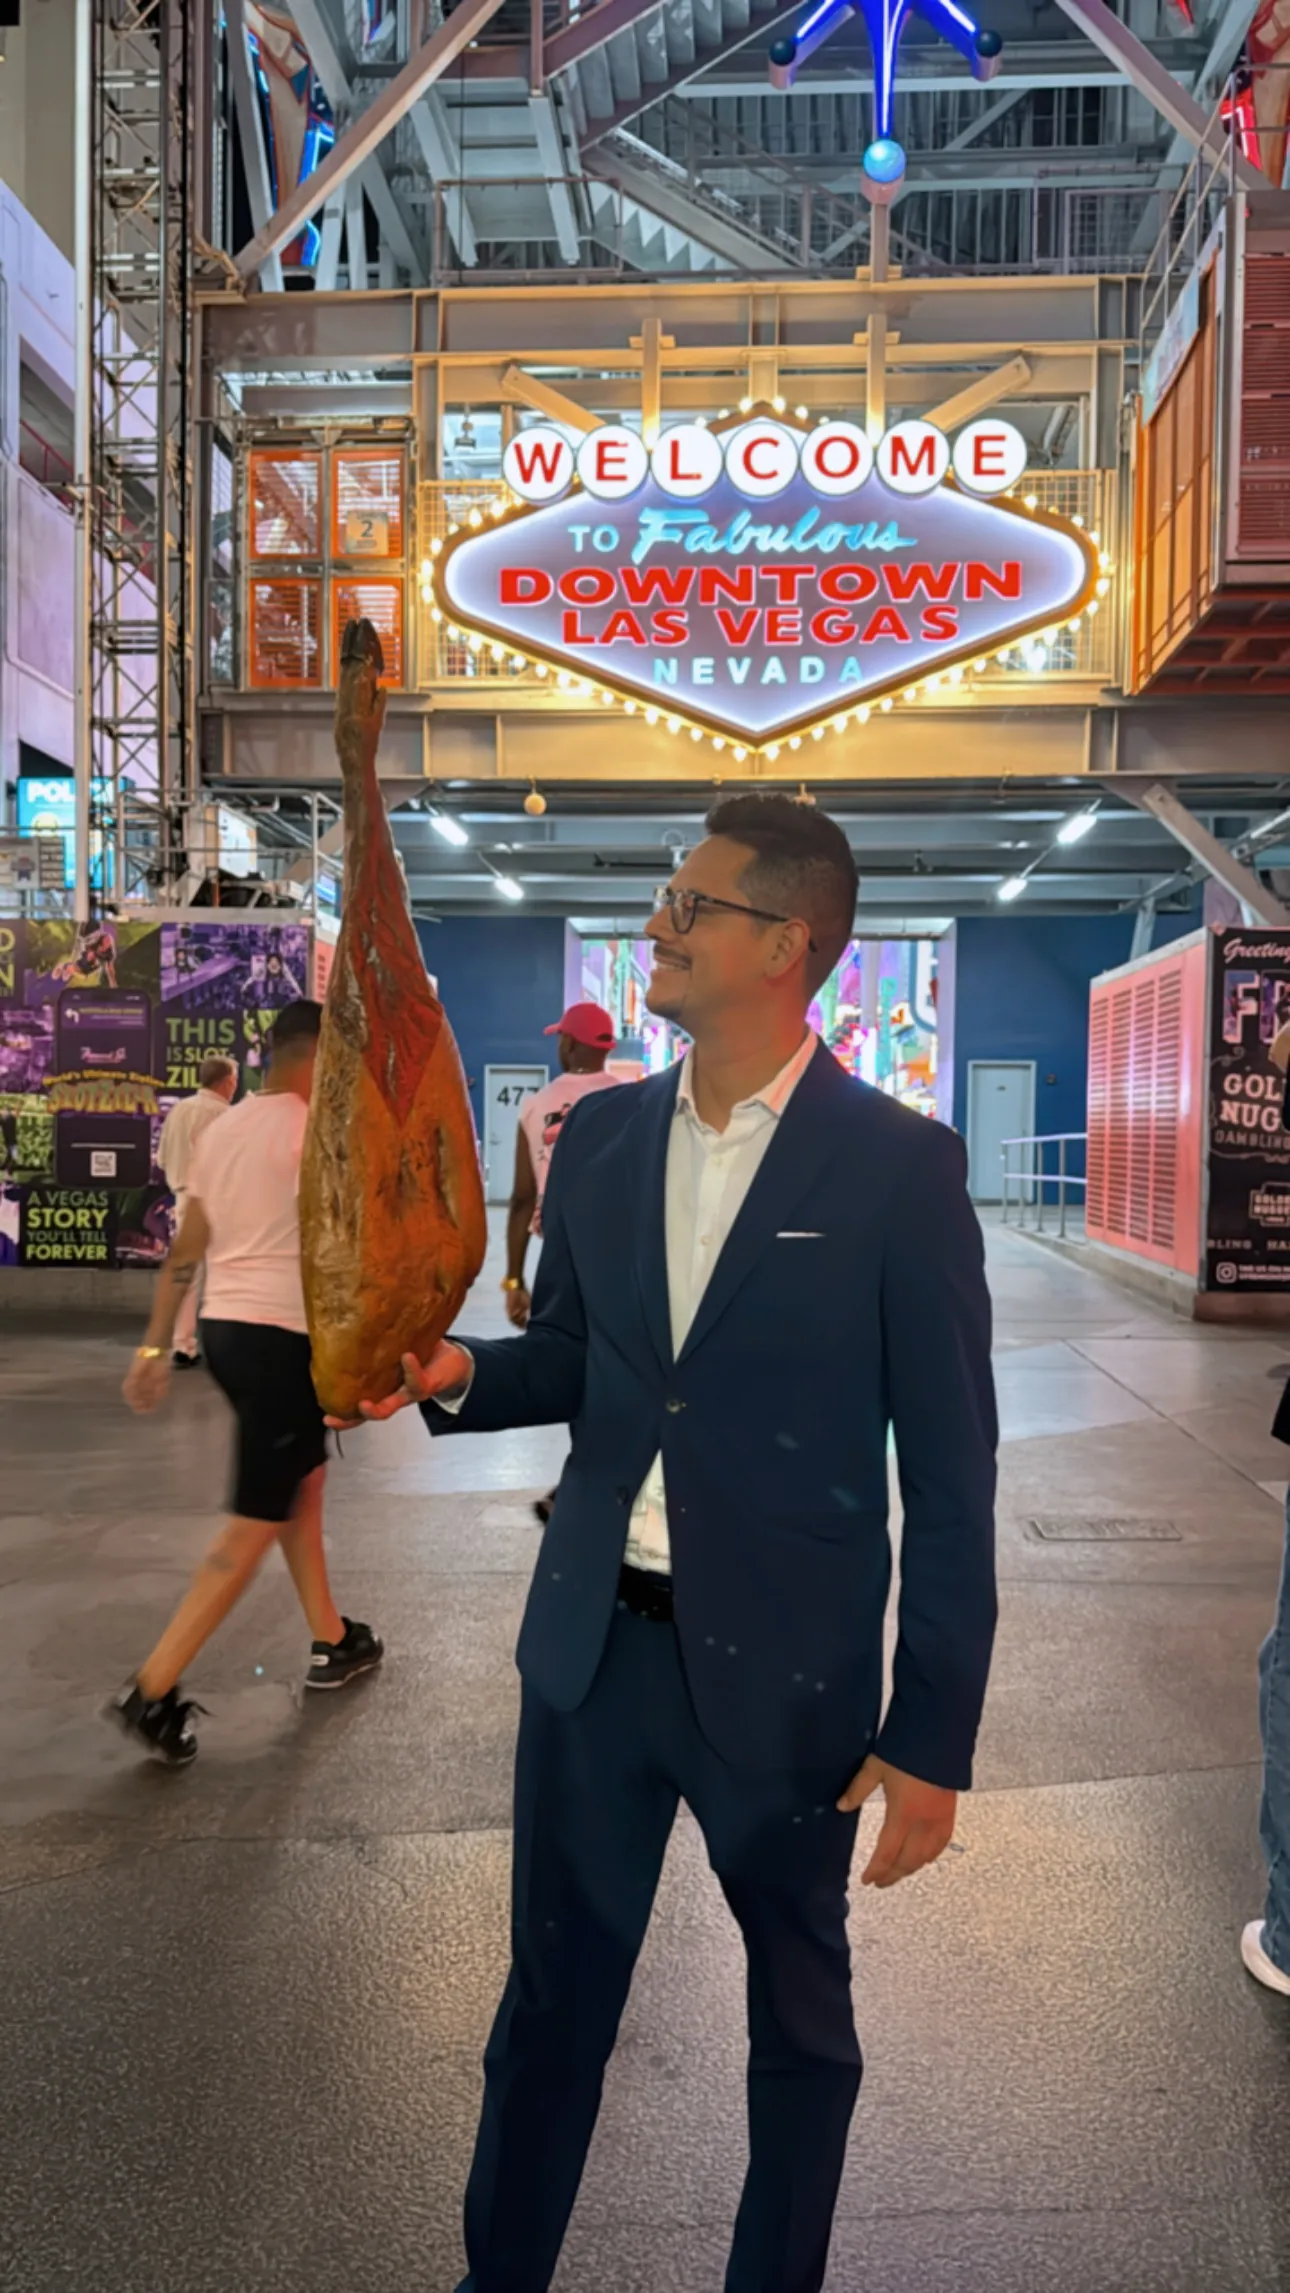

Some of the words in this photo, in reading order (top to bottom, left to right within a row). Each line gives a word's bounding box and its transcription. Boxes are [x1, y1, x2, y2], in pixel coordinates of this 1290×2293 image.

[513, 433, 1007, 485] WELCOME
[361, 519, 373, 538] 2
[568, 524, 620, 553] TO
[630, 505, 919, 566] Fabulous
[499, 560, 1023, 606] DOWNTOWN
[562, 607, 690, 647] LAS
[714, 604, 961, 647] VEGAS
[652, 655, 864, 685] NEVADA
[165, 1016, 236, 1045] THIS
[166, 1046, 183, 1063] IS
[27, 1191, 42, 1206] A
[46, 1190, 108, 1207] VEGAS
[27, 1207, 109, 1229] STORY
[26, 1244, 108, 1260] FOREVER
